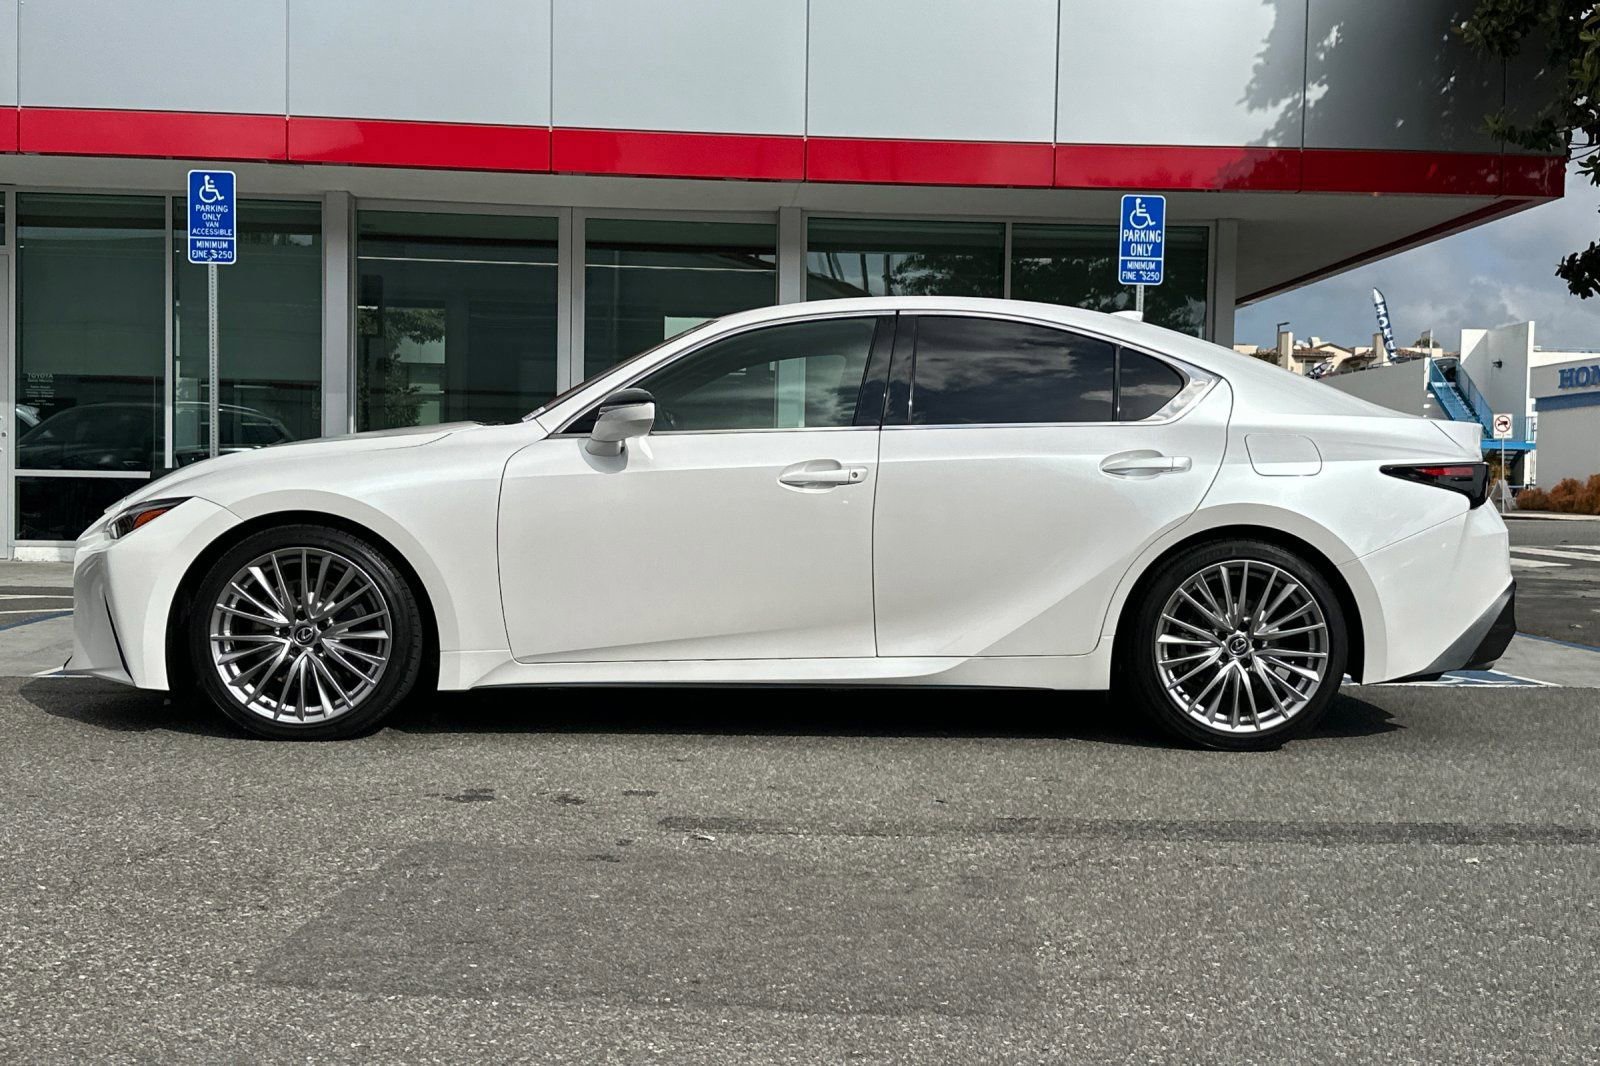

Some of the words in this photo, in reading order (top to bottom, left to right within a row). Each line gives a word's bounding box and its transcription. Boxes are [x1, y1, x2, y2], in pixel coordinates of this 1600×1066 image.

[1123, 229, 1161, 243] PARKING
[192, 250, 208, 258] FINE
[1130, 243, 1153, 256] ONLY
[1127, 261, 1155, 270] MINIMUM
[1122, 271, 1136, 280] FINE
